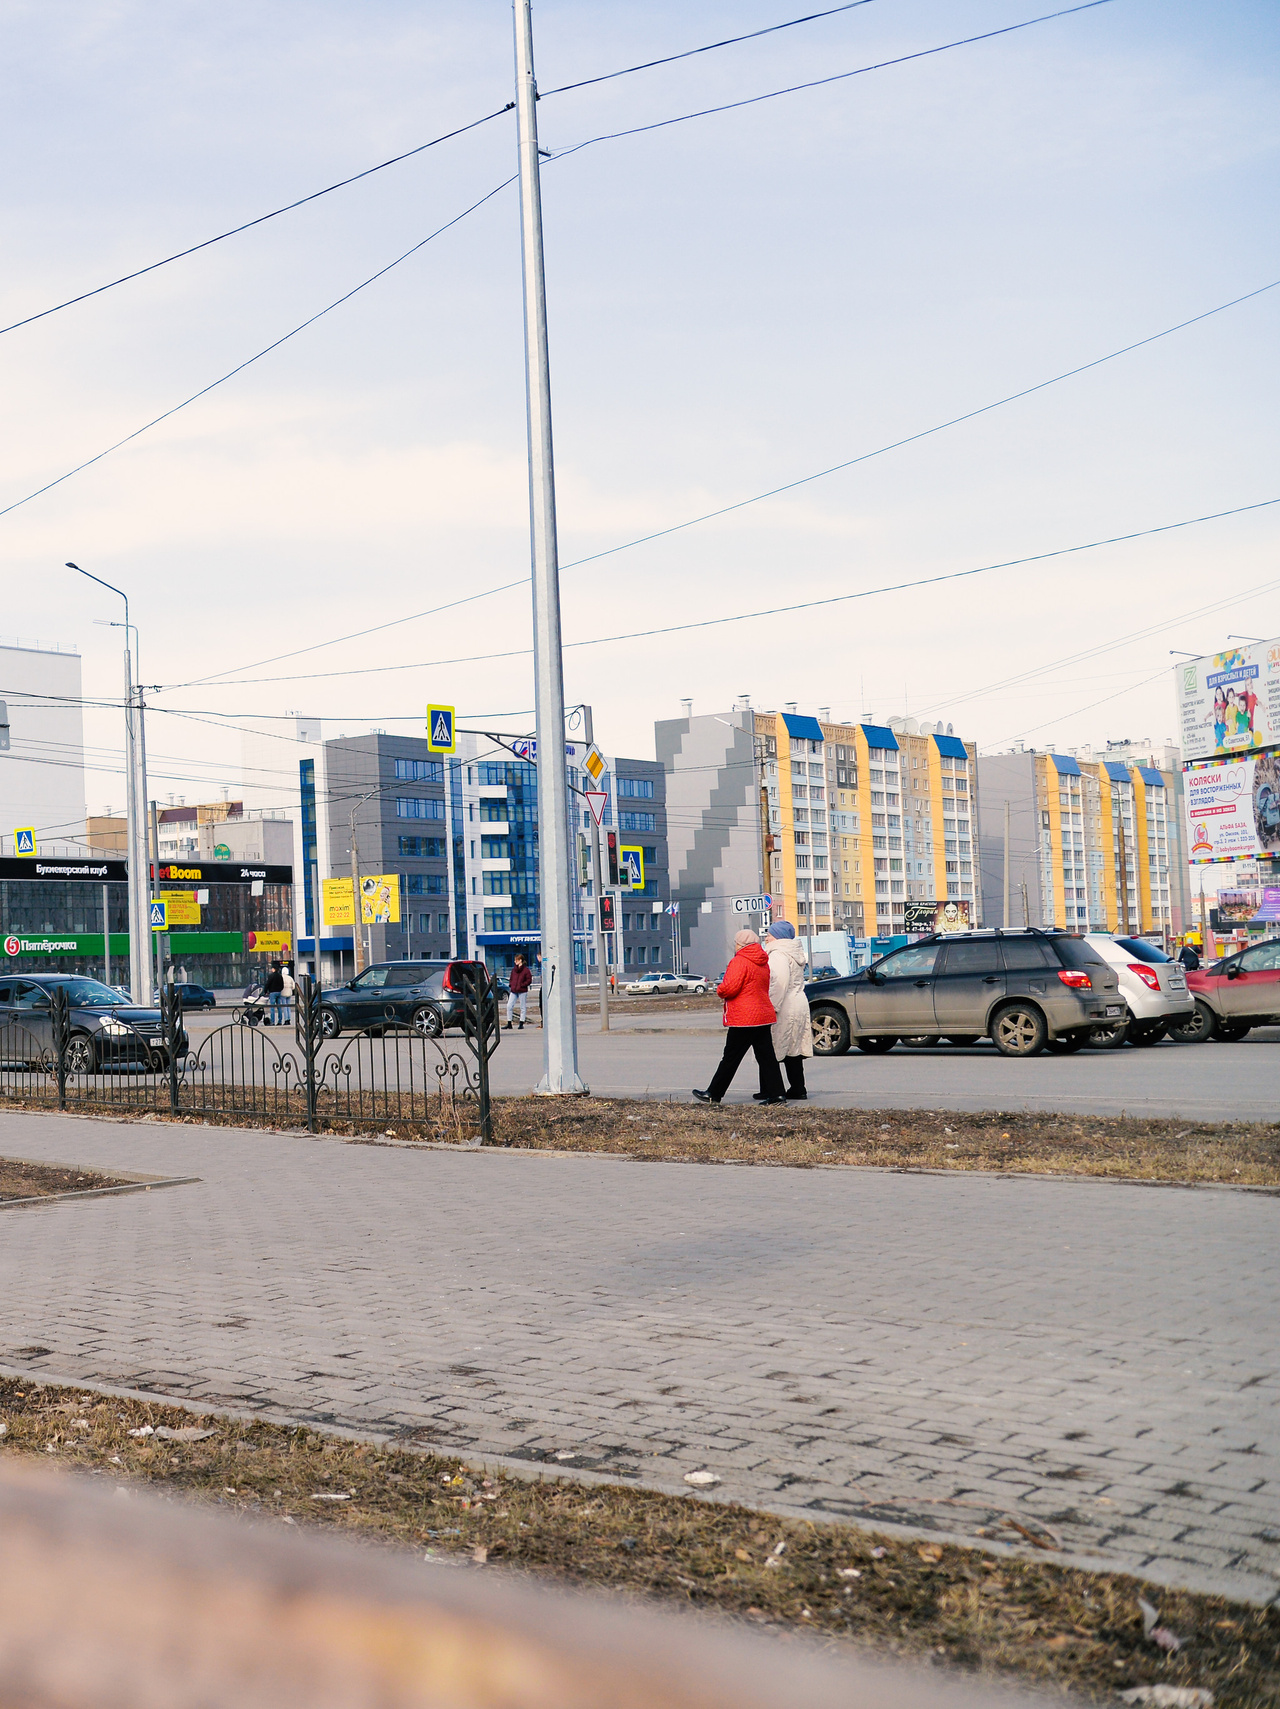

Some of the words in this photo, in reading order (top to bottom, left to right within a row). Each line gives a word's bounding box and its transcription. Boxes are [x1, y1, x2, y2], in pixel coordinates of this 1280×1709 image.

[1189, 774, 1221, 787] КОЛЯСКИ
[1189, 788, 1200, 797] ДЛЯ
[1200, 782, 1241, 795] ВОСТОРЖЕННЫХ
[1190, 796, 1215, 806] ВЗГЛЯДОВ
[36, 864, 89, 876] Букмекерский
[90, 865, 108, 877] клуб
[240, 868, 249, 877] 24
[735, 898, 764, 911] СТОП
[905, 906, 938, 921] Глория
[604, 918, 614, 928] 55
[21, 940, 77, 953] Пятёрочка
